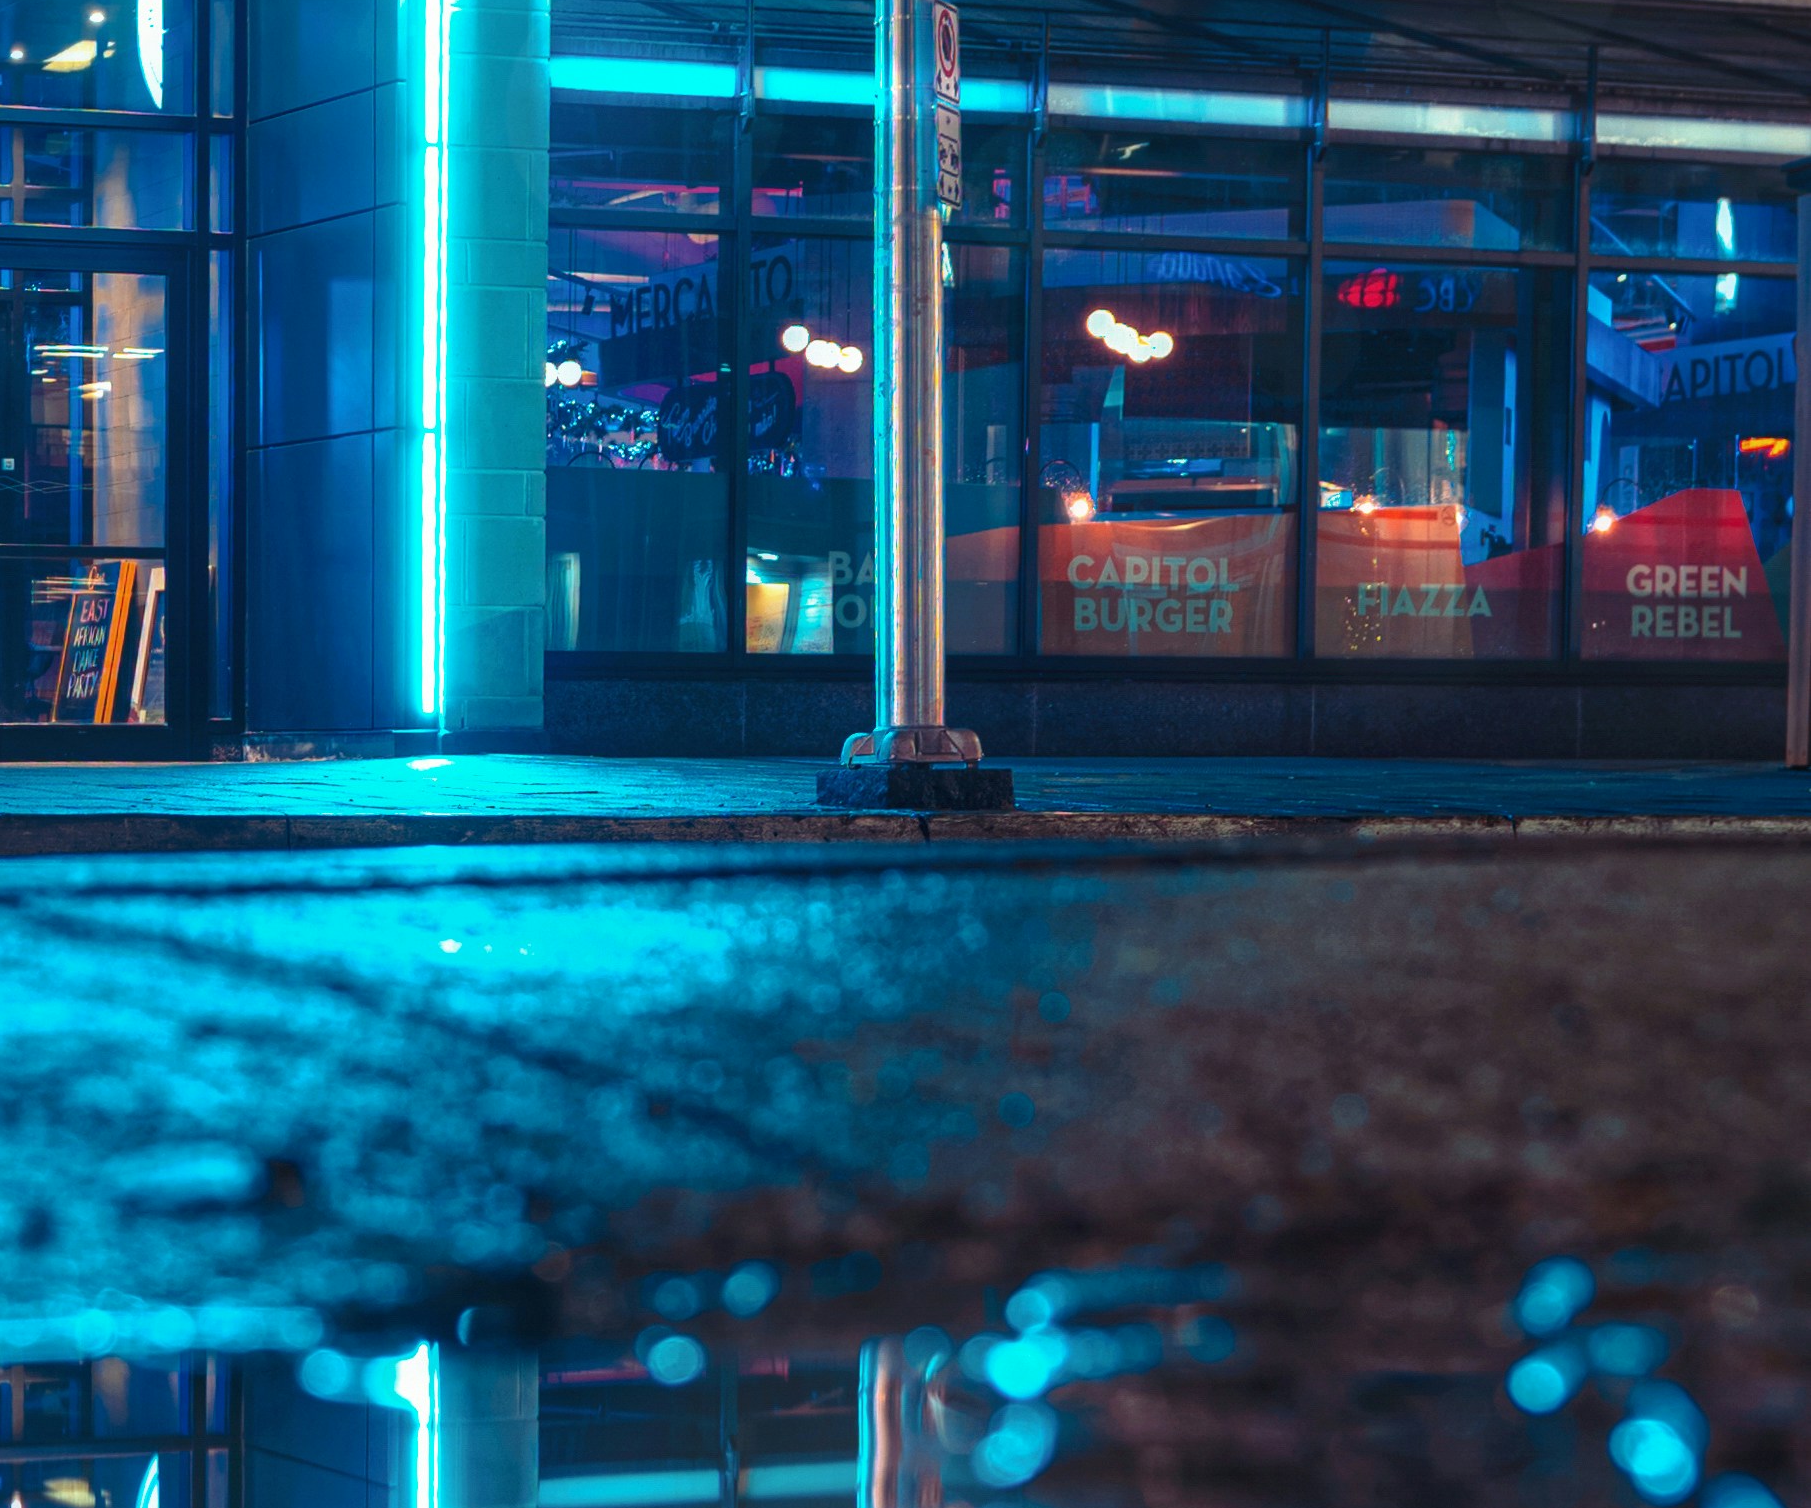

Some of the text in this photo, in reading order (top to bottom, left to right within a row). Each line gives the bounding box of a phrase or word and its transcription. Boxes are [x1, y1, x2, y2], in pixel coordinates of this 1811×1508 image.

[1660, 347, 1797, 403] APITOL
[1067, 554, 1239, 592] CAPITOL
[1626, 563, 1748, 599] GREEN
[80, 598, 110, 623] EAST
[1073, 596, 1234, 634] BURGER
[1631, 604, 1743, 639] REBEL
[66, 671, 100, 699] PARTY
